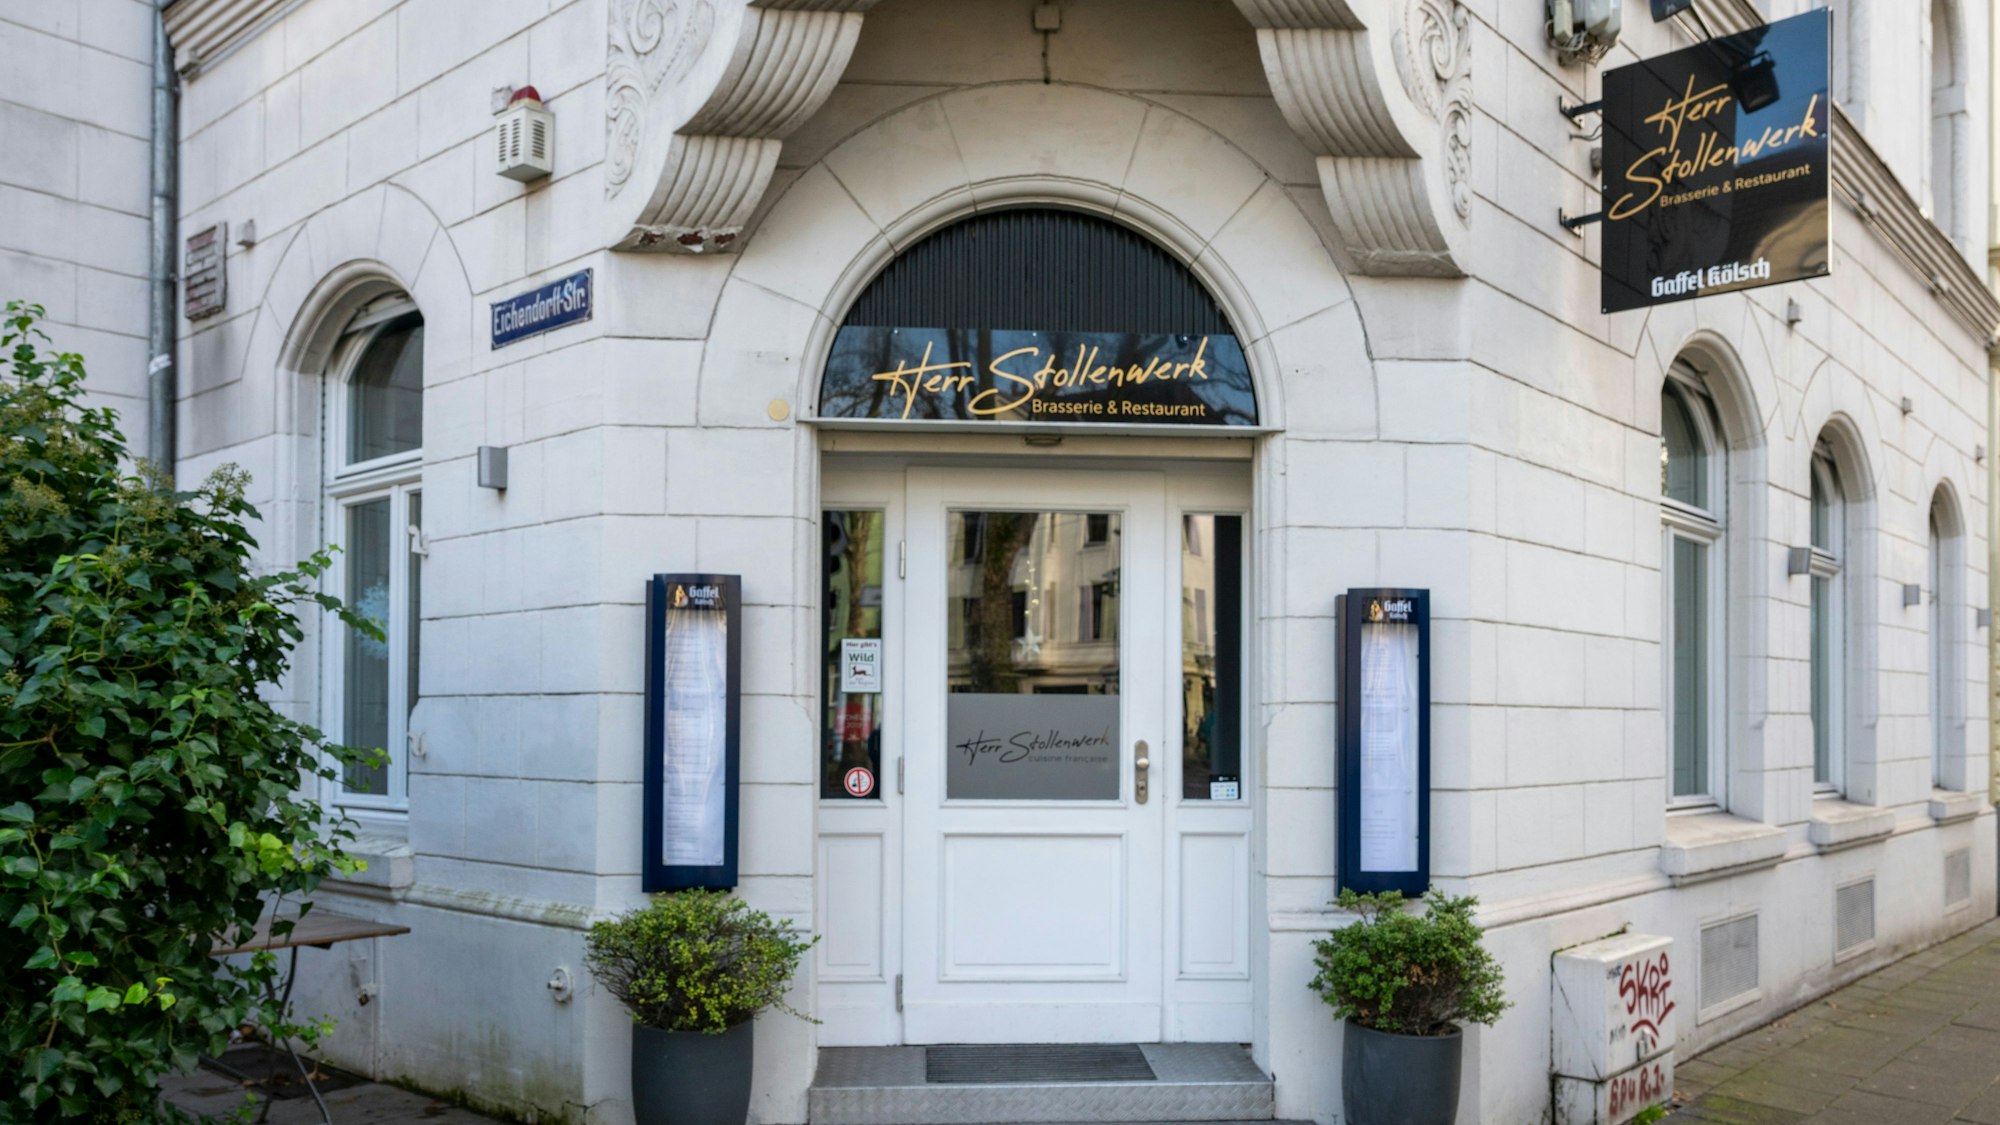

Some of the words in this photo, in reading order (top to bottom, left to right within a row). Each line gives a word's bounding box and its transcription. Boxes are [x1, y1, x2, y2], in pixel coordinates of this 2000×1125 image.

[1644, 74, 1732, 152] Herr
[1608, 94, 1818, 220] Stollenwerk
[1659, 184, 1720, 208] Brasserie
[1722, 180, 1733, 193] &
[1734, 163, 1811, 191] Restaurant
[1651, 269, 1704, 298] Gaffel
[1707, 257, 1771, 287] Kölsch
[494, 279, 586, 336] Eichendorff-Str.
[871, 340, 976, 420] Herr
[968, 336, 1209, 416] Stollenwerk
[1032, 399, 1103, 415] Brasserie
[1106, 399, 1118, 415] &
[1121, 400, 1206, 417] Restaurant
[689, 585, 719, 598] Gaffel
[1384, 600, 1412, 612] Gaffel
[848, 652, 875, 663] Wild
[955, 729, 1003, 766] Herr
[1000, 726, 1110, 763] Stollenwerk
